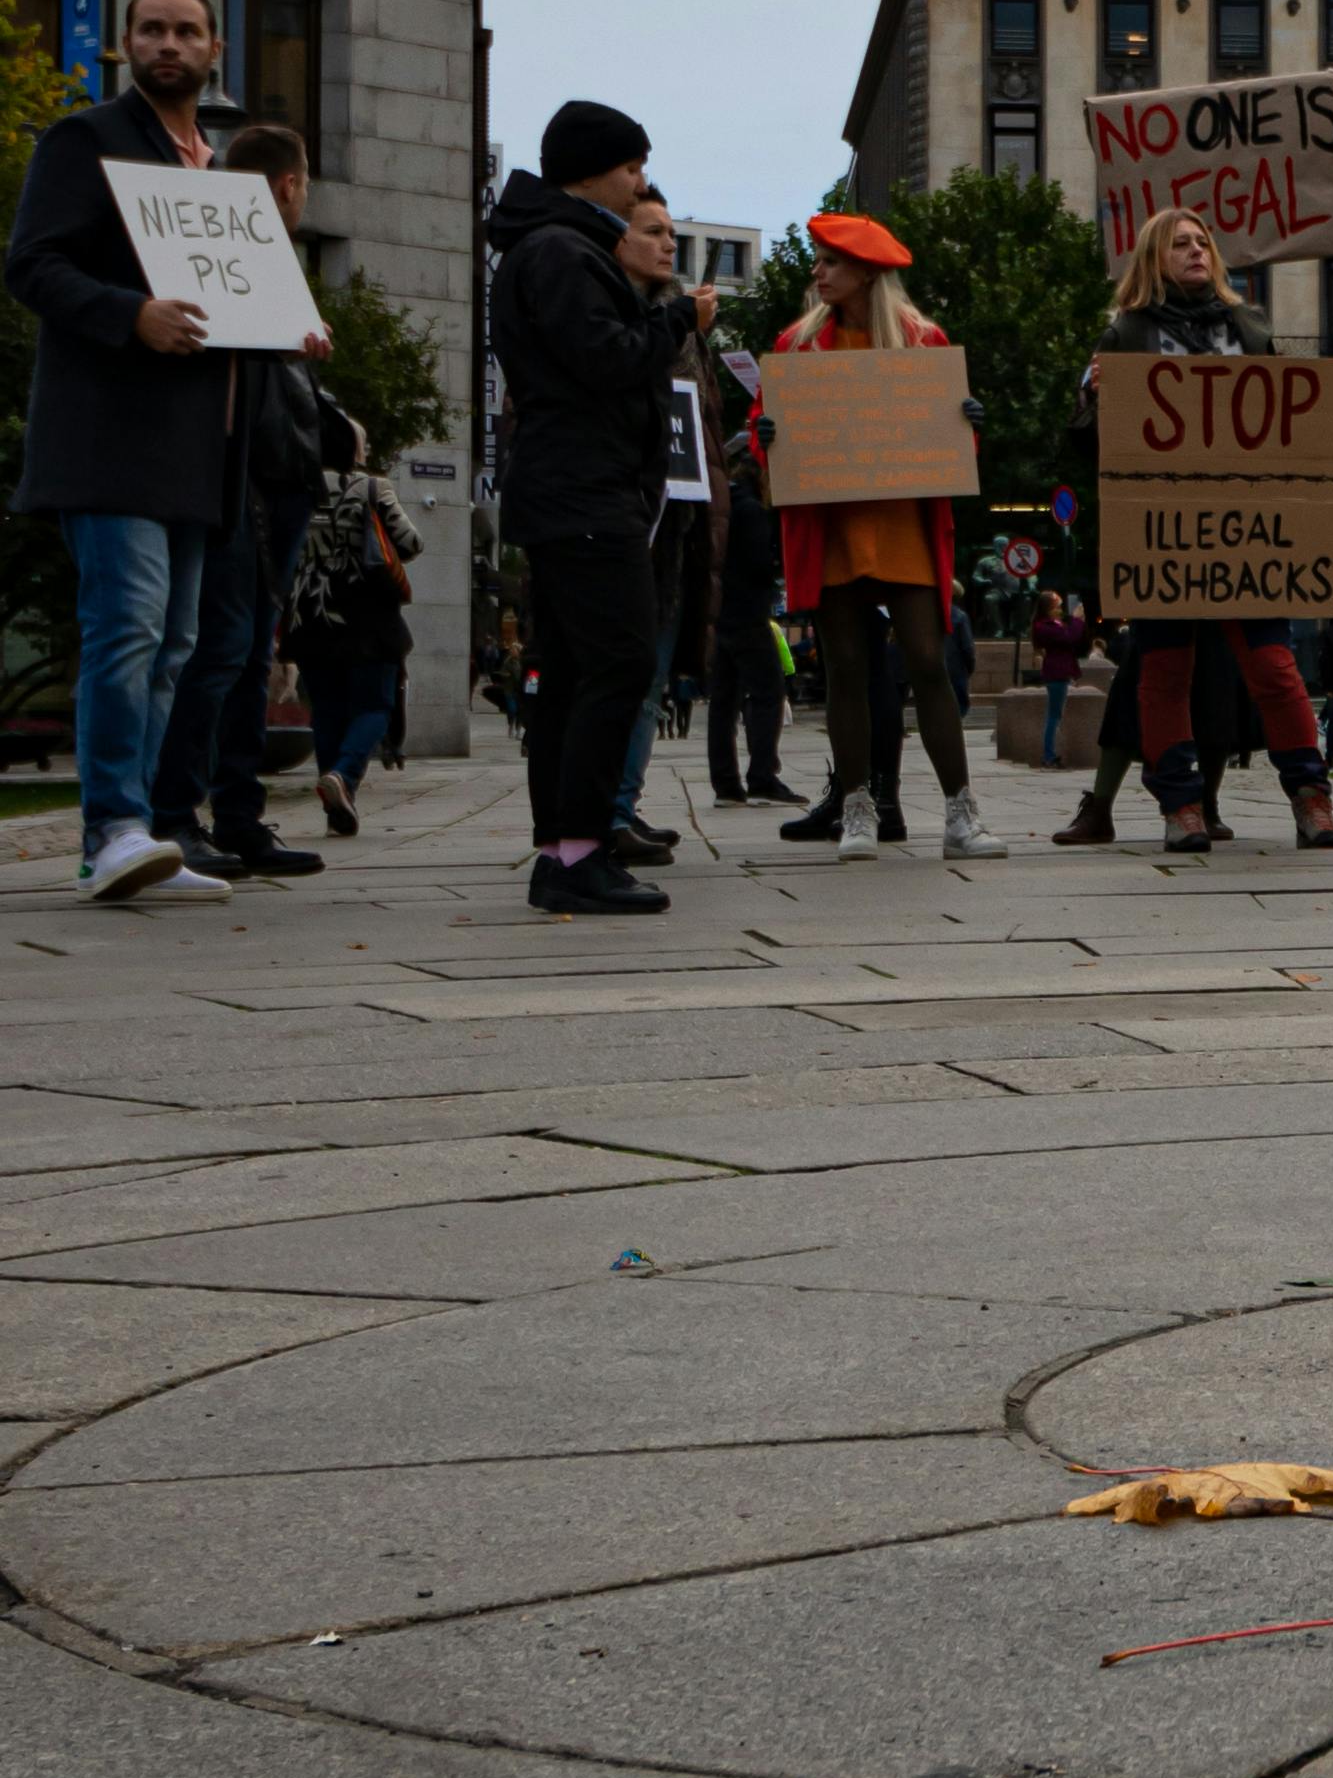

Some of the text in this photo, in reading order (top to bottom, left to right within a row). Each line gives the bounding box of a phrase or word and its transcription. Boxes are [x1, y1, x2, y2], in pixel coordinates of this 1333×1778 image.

[1095, 102, 1181, 165] NO
[1185, 88, 1283, 153] ONE
[187, 254, 252, 295] PIS
[1143, 360, 1320, 451] STOP
[1145, 509, 1294, 551] ILLEGAL
[1112, 556, 1333, 604] PUSHBACKS
